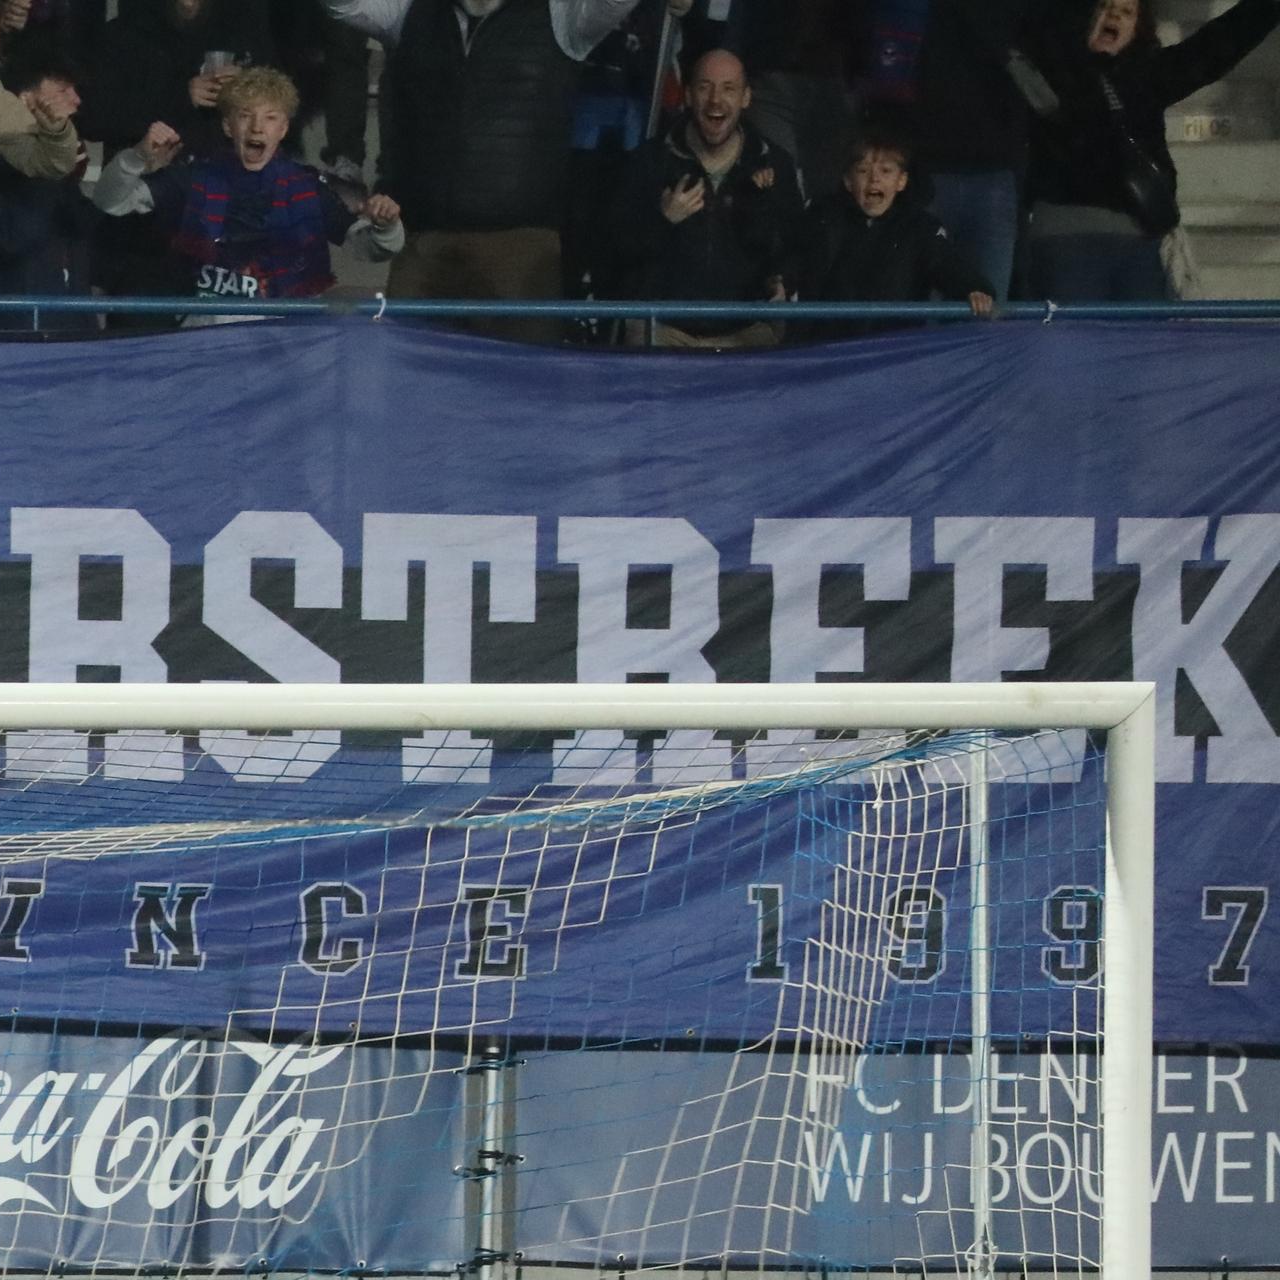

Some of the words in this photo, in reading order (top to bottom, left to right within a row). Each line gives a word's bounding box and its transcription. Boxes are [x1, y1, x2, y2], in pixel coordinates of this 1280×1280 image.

[197, 264, 258, 298] STAR
[746, 884, 1269, 987] 1997
[933, 1049, 1248, 1115] DENER
[804, 1131, 934, 1204] WIJ
